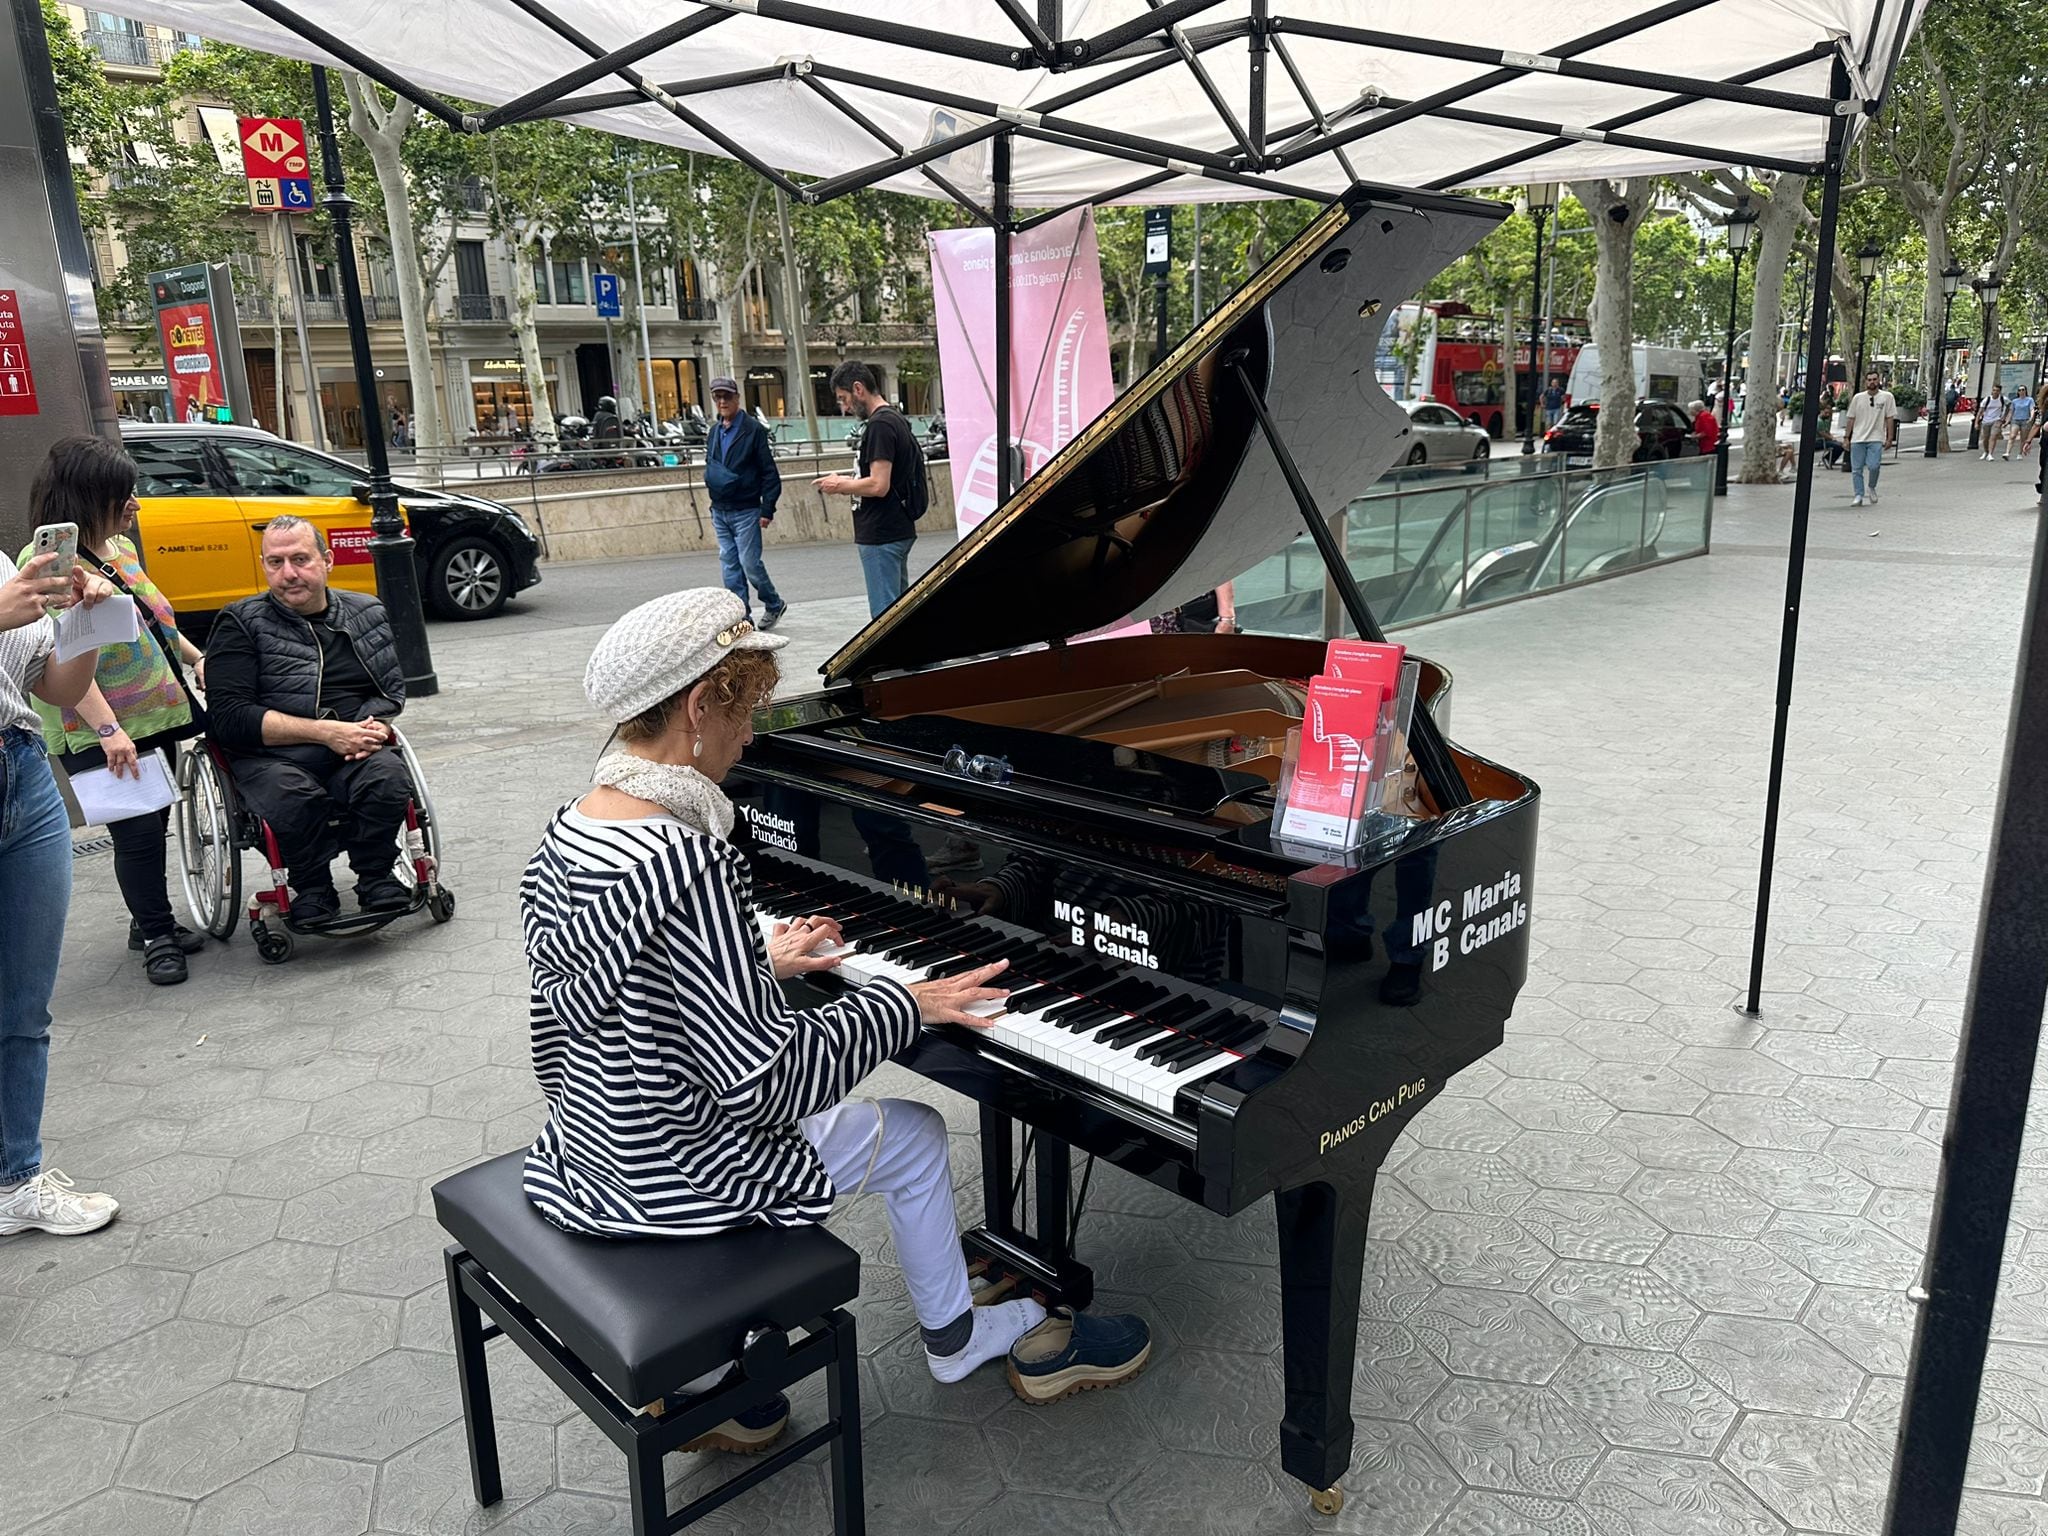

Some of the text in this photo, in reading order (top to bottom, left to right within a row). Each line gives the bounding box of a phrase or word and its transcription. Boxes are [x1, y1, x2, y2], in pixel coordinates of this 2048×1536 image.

[259, 132, 284, 152] M
[600, 280, 611, 296] P
[110, 375, 168, 387] CHAEL KO
[331, 536, 377, 548] FREEN
[750, 808, 796, 835] Occident
[751, 824, 798, 852] Fundació
[892, 877, 957, 912] YAMAHA
[1411, 870, 1521, 947] MC Maria
[1054, 899, 1150, 946] MC Maria
[1432, 900, 1527, 972] B Canals
[1071, 925, 1159, 970] B Canals
[1320, 1114, 1366, 1155] PIANOS
